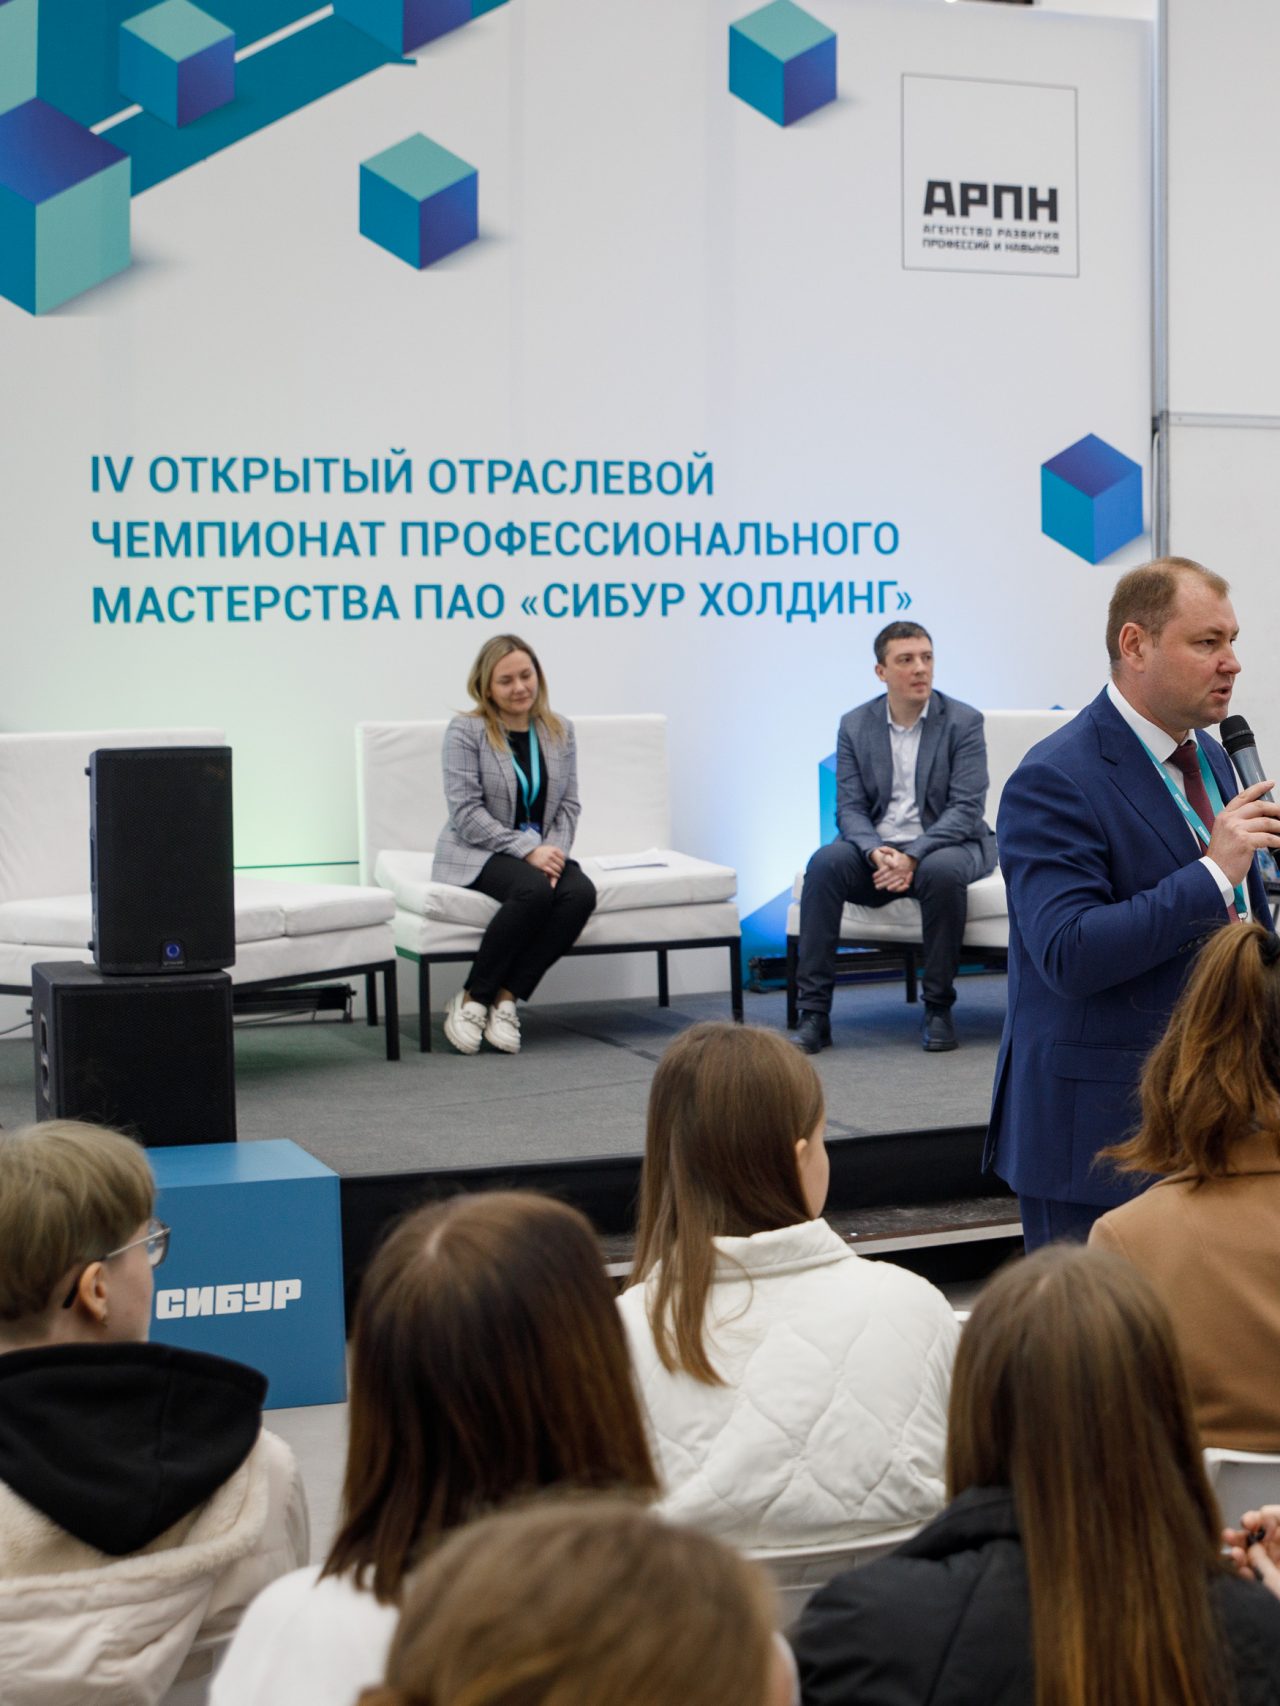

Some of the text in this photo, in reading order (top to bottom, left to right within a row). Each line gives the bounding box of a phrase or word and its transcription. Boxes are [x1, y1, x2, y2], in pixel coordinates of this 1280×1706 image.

[923, 180, 1058, 223] АРПН
[922, 237, 1060, 255] ПРОФЕССИЙ И НАВЫКОВ
[923, 224, 1060, 240] АГЕНТСТВО РАЗВИТИЯ
[91, 447, 714, 496] IV ОТКРЫТЫЙ ОТРАСЛЕВОЙ
[92, 521, 899, 558] ЧЕМПИОНАТ ПРОФЕССИОНАЛЬНОГО
[93, 580, 912, 623] МАСТЕРСТВА ПАО «СИБУР ХОЛДИНГ»
[156, 1278, 302, 1320] СИБУР
